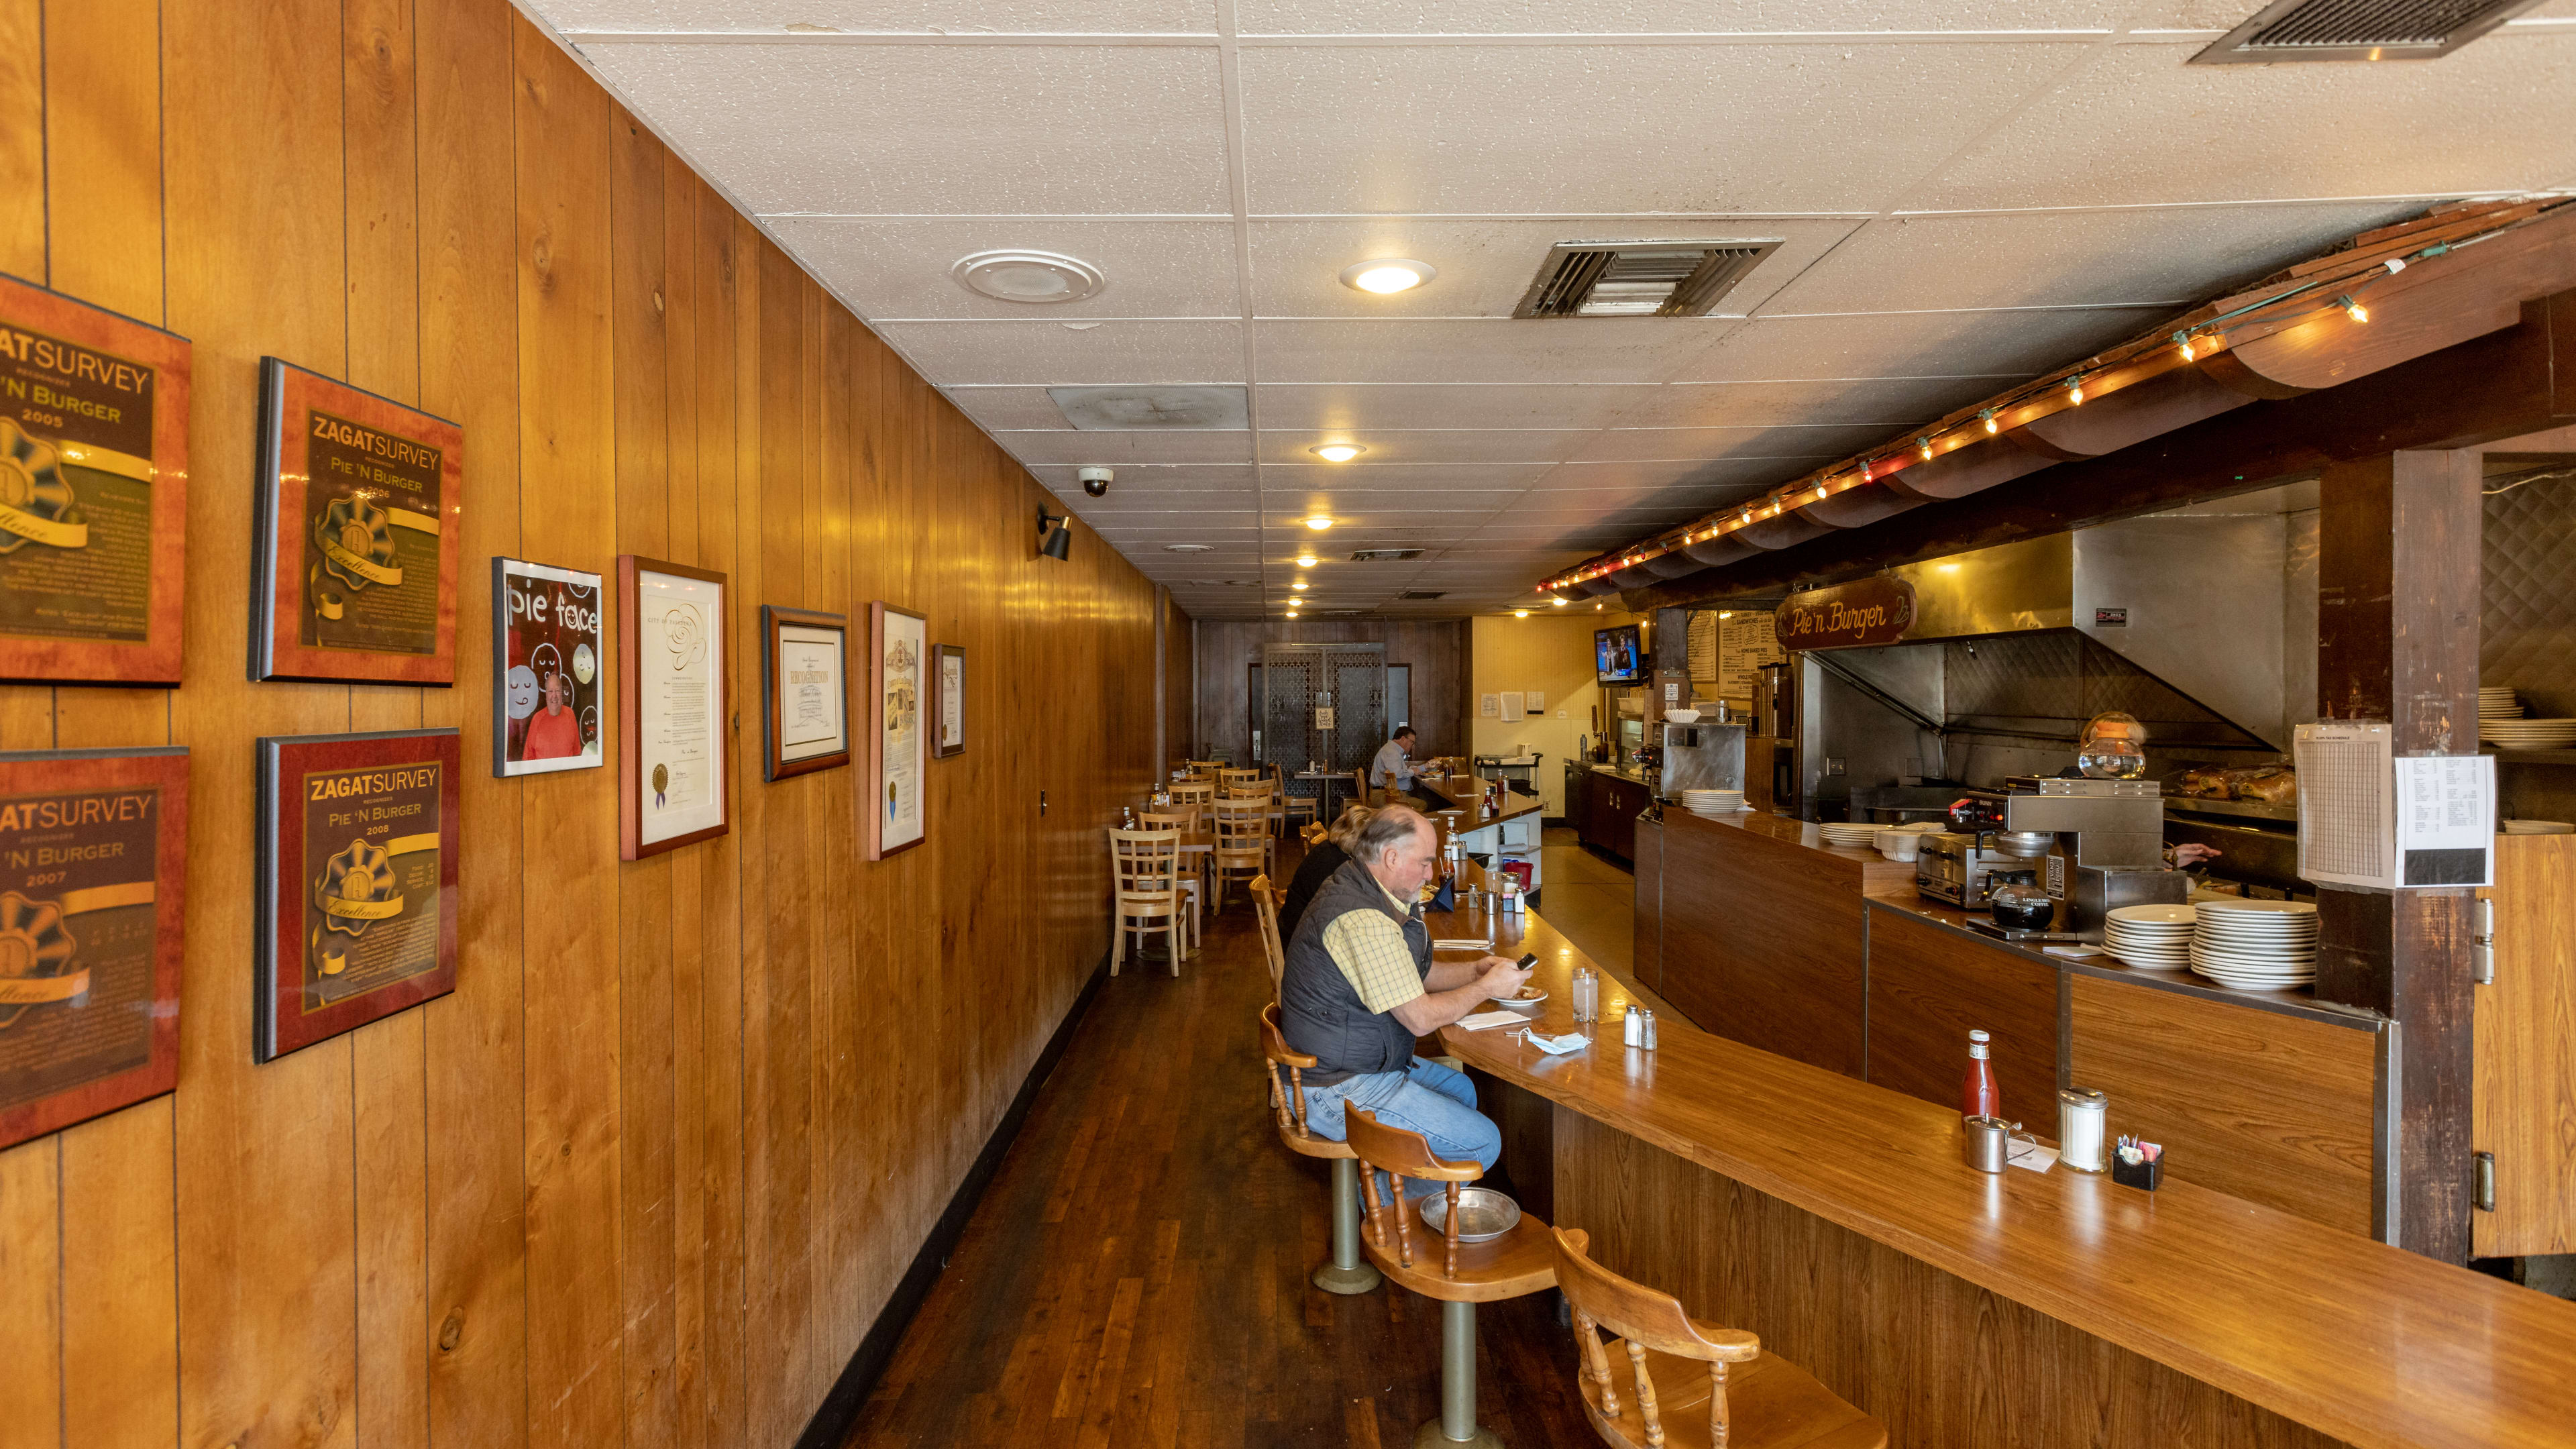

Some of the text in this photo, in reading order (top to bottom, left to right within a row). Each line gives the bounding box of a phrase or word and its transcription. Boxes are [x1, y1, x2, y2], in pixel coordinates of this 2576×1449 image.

[0, 328, 148, 394] ATSURVEY
[22, 408, 64, 428] 2005
[34, 384, 121, 423] BURGER
[313, 416, 438, 470] ZAGATSURVEY
[331, 457, 354, 475] PIE
[374, 468, 423, 493] BURGER
[367, 486, 390, 498] 2006
[327, 545, 380, 580] Excellence
[508, 578, 597, 634] pie face
[1827, 600, 1886, 639] Burger
[790, 670, 828, 684] RECOGNITION
[311, 768, 437, 801] ZAGATSURVEY
[0, 794, 152, 832] ATSURVEY
[329, 812, 352, 827] PIE
[372, 803, 422, 820] BURGER
[366, 824, 390, 836] 2008
[37, 842, 125, 866] BURGER
[26, 871, 67, 888] 2007
[327, 900, 382, 917] Excellence
